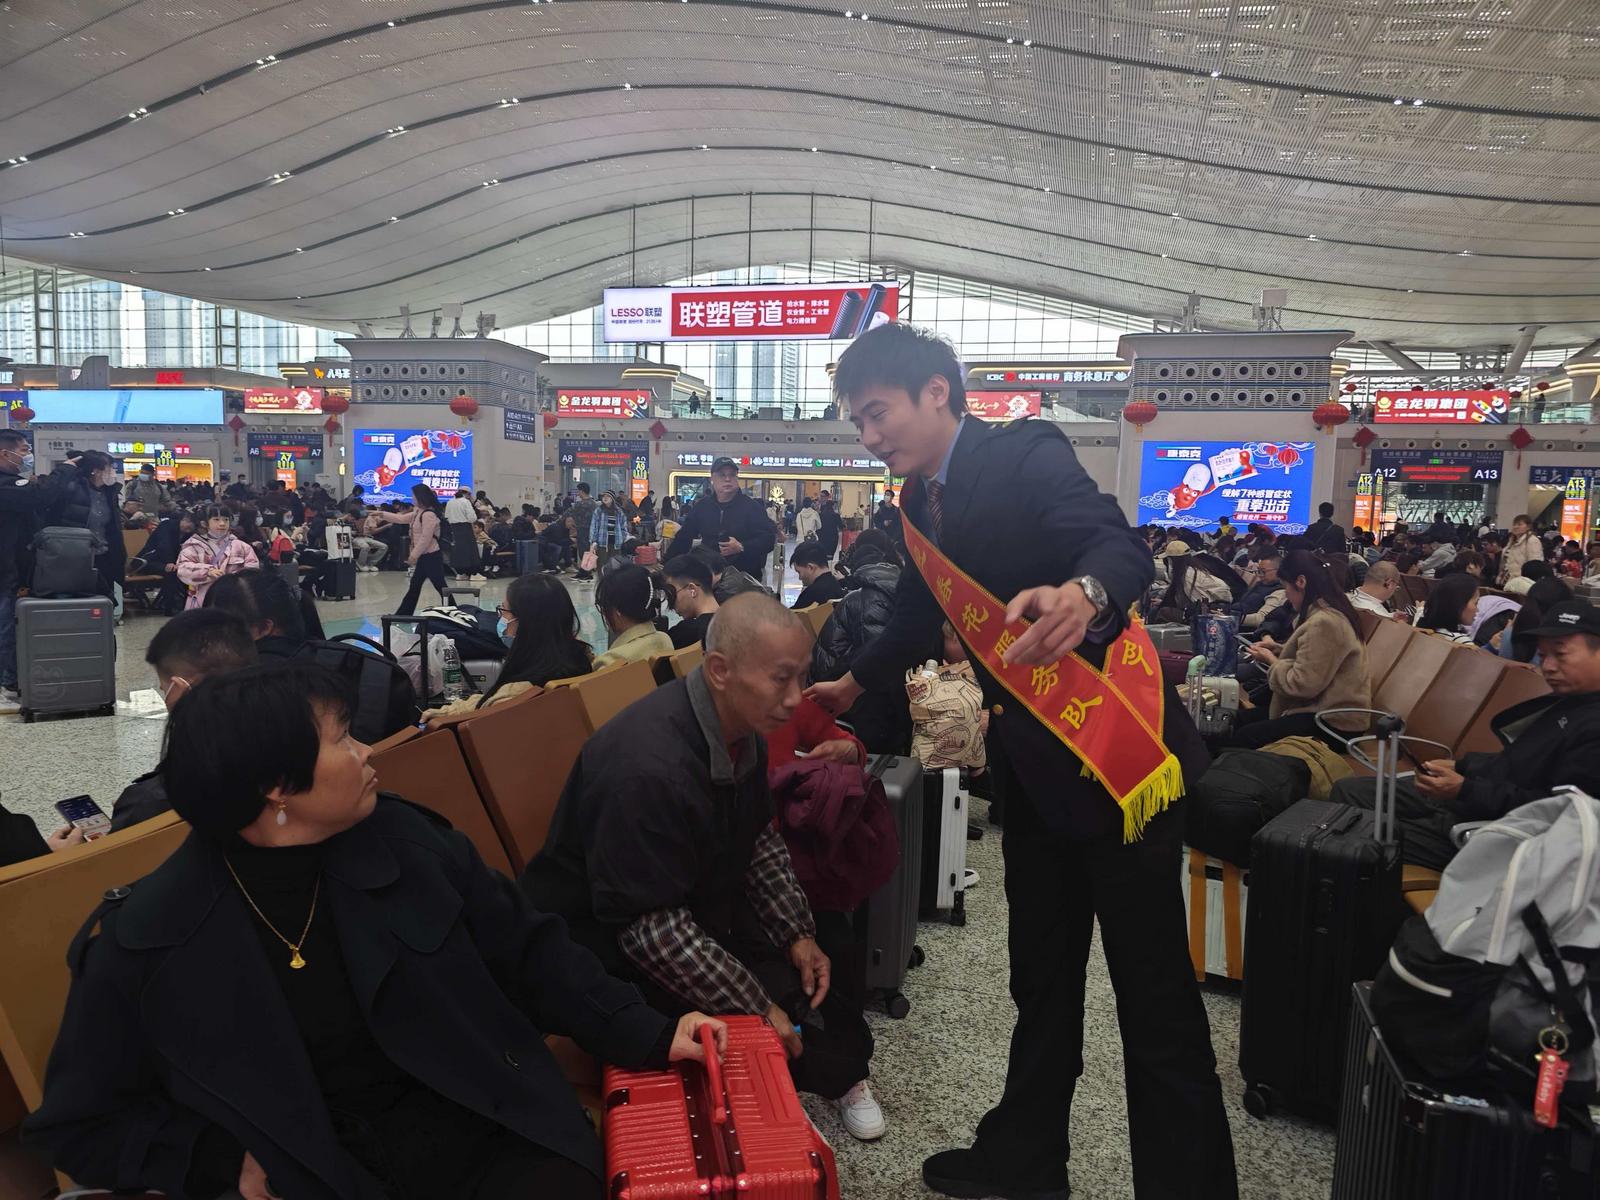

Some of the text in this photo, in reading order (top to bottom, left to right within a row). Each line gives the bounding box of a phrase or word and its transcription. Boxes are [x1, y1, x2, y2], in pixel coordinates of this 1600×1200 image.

[611, 307, 663, 317] LESSO 联塑
[679, 300, 783, 328] 联塑管道
[1063, 371, 1114, 382] 商务休息厅
[571, 396, 622, 406] 金龙羽集团
[1393, 398, 1469, 409] 金龙羽集团
[249, 447, 260, 456] A6
[311, 448, 322, 457] A7
[280, 452, 293, 462] A7
[562, 454, 573, 463] A8
[1375, 468, 1397, 478] A12
[1475, 469, 1498, 479] A13
[1358, 475, 1373, 487] A12
[1567, 479, 1586, 489] A13
[1221, 489, 1293, 499] 缓解7种感冒症状
[1236, 499, 1291, 513] 重拳出击
[1122, 640, 1154, 676] 队
